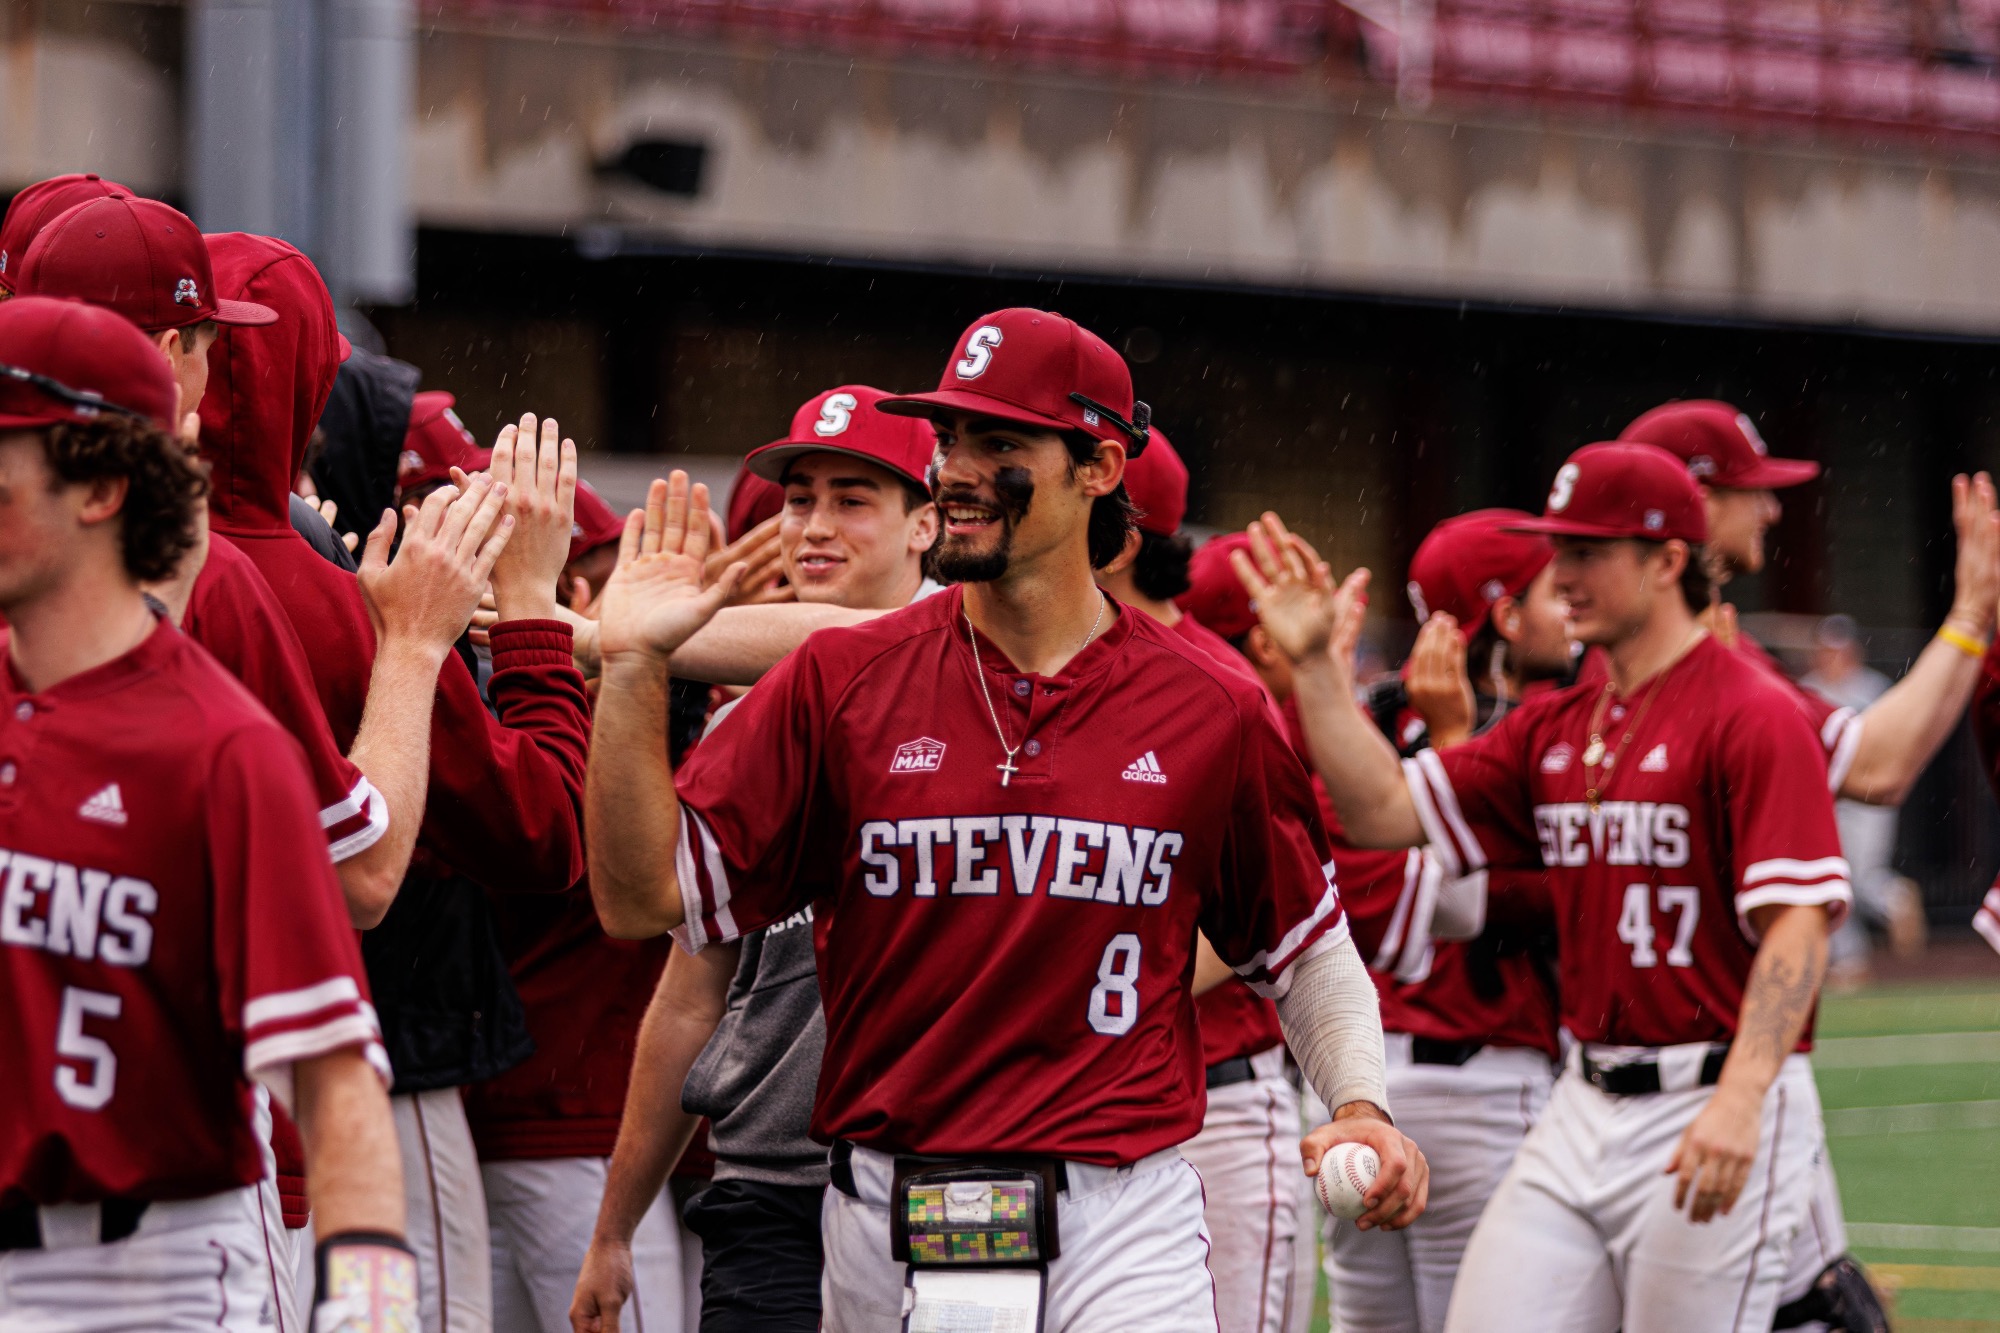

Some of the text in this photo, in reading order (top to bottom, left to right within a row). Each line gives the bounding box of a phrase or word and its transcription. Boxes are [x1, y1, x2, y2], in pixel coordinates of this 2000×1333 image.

[956, 325, 1004, 380] S
[813, 393, 858, 437] S
[1547, 461, 1580, 513] S
[895, 754, 939, 769] MAC
[1122, 769, 1167, 784] adidas
[859, 814, 1184, 907] STEVENS
[0, 847, 159, 967] ENS
[1616, 882, 1701, 968] 47
[1087, 932, 1143, 1037] 8
[54, 986, 121, 1112] 5
